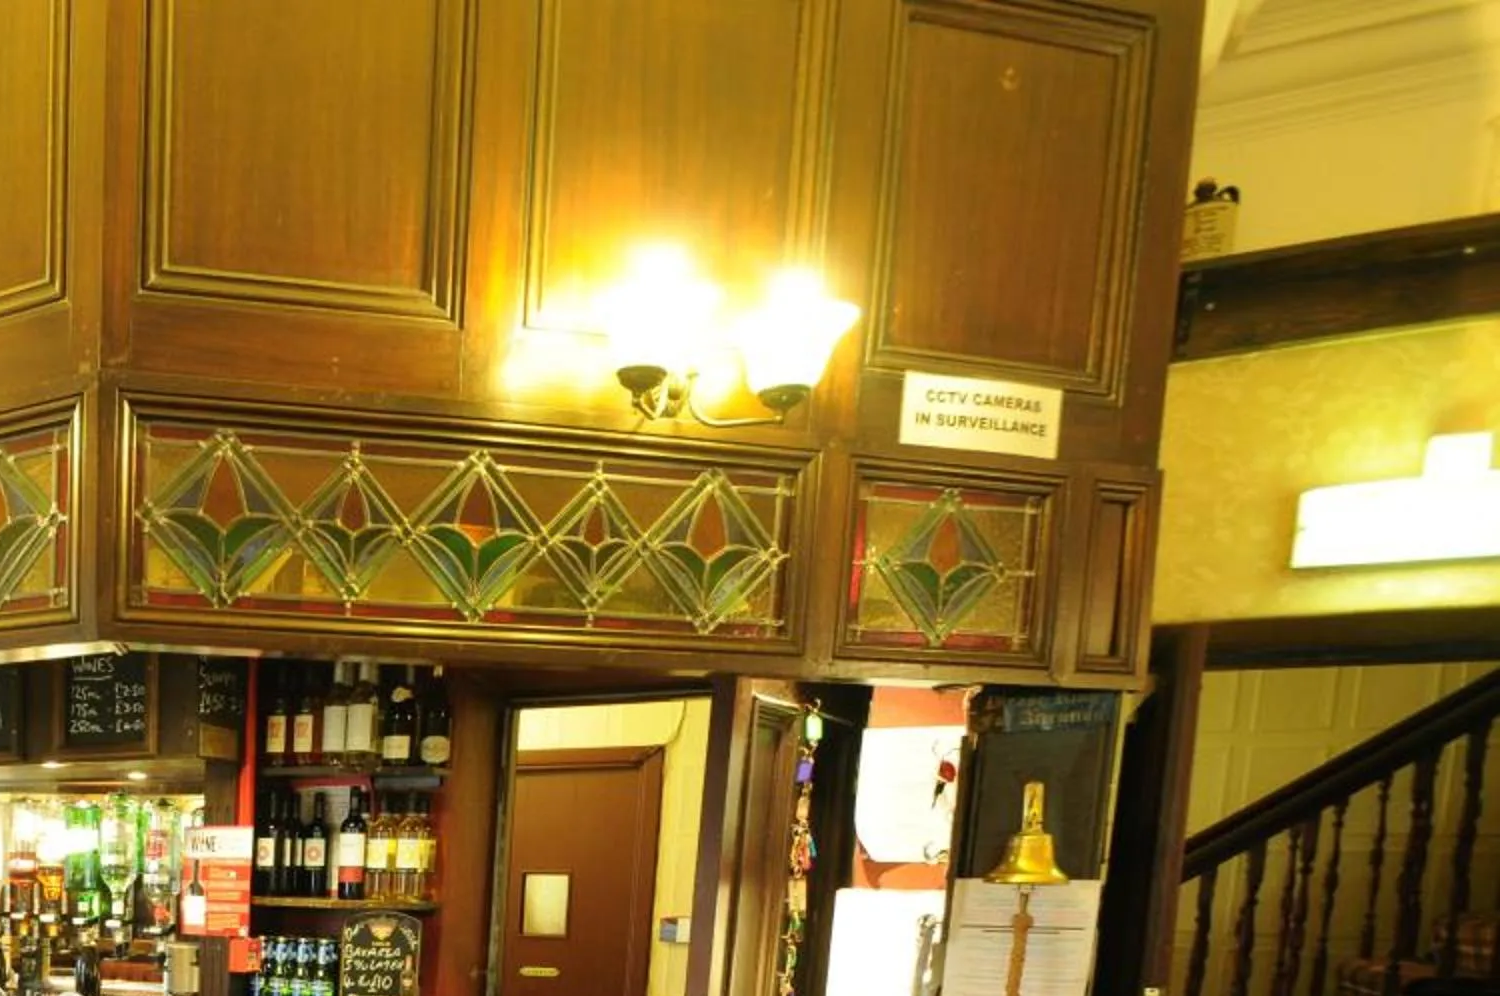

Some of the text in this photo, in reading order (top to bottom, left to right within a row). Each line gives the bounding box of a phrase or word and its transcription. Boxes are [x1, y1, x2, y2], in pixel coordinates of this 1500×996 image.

[926, 388, 1043, 414] CCTV CAMERAS
[915, 412, 1047, 438] IN SURVEILLANCE
